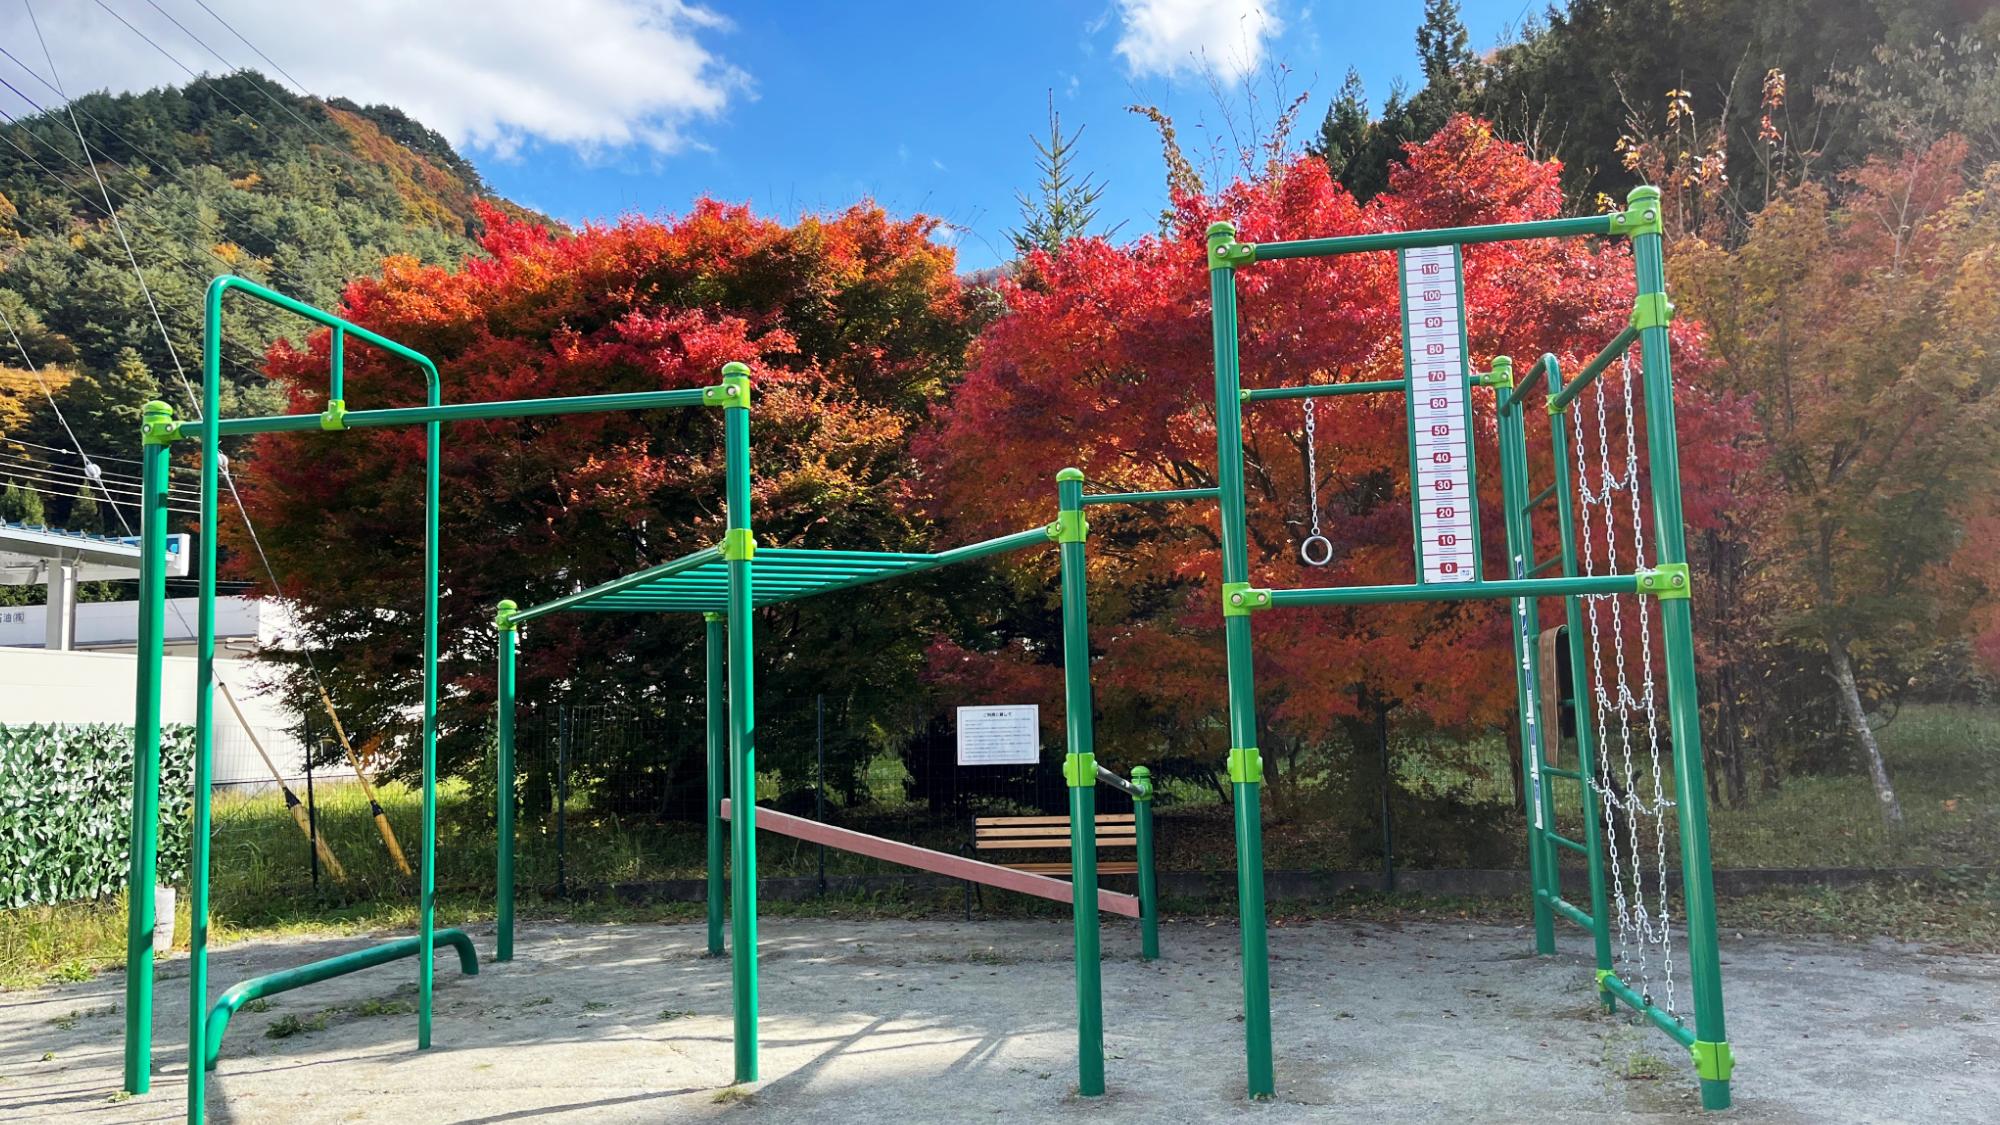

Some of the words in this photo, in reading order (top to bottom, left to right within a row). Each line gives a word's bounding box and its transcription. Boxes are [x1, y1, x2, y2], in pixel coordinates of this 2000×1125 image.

[1423, 264, 1439, 274] 110
[1424, 291, 1440, 300] 100
[1427, 318, 1440, 327] 90
[1429, 345, 1442, 354] 80
[1431, 371, 1444, 381] 70
[1432, 398, 1445, 408] 60
[1434, 426, 1447, 435] 50
[1435, 453, 1449, 462] 40
[1437, 481, 1450, 490] 30
[1439, 508, 1452, 517] 20
[1441, 535, 1454, 545] 10
[1445, 563, 1452, 573] 0
